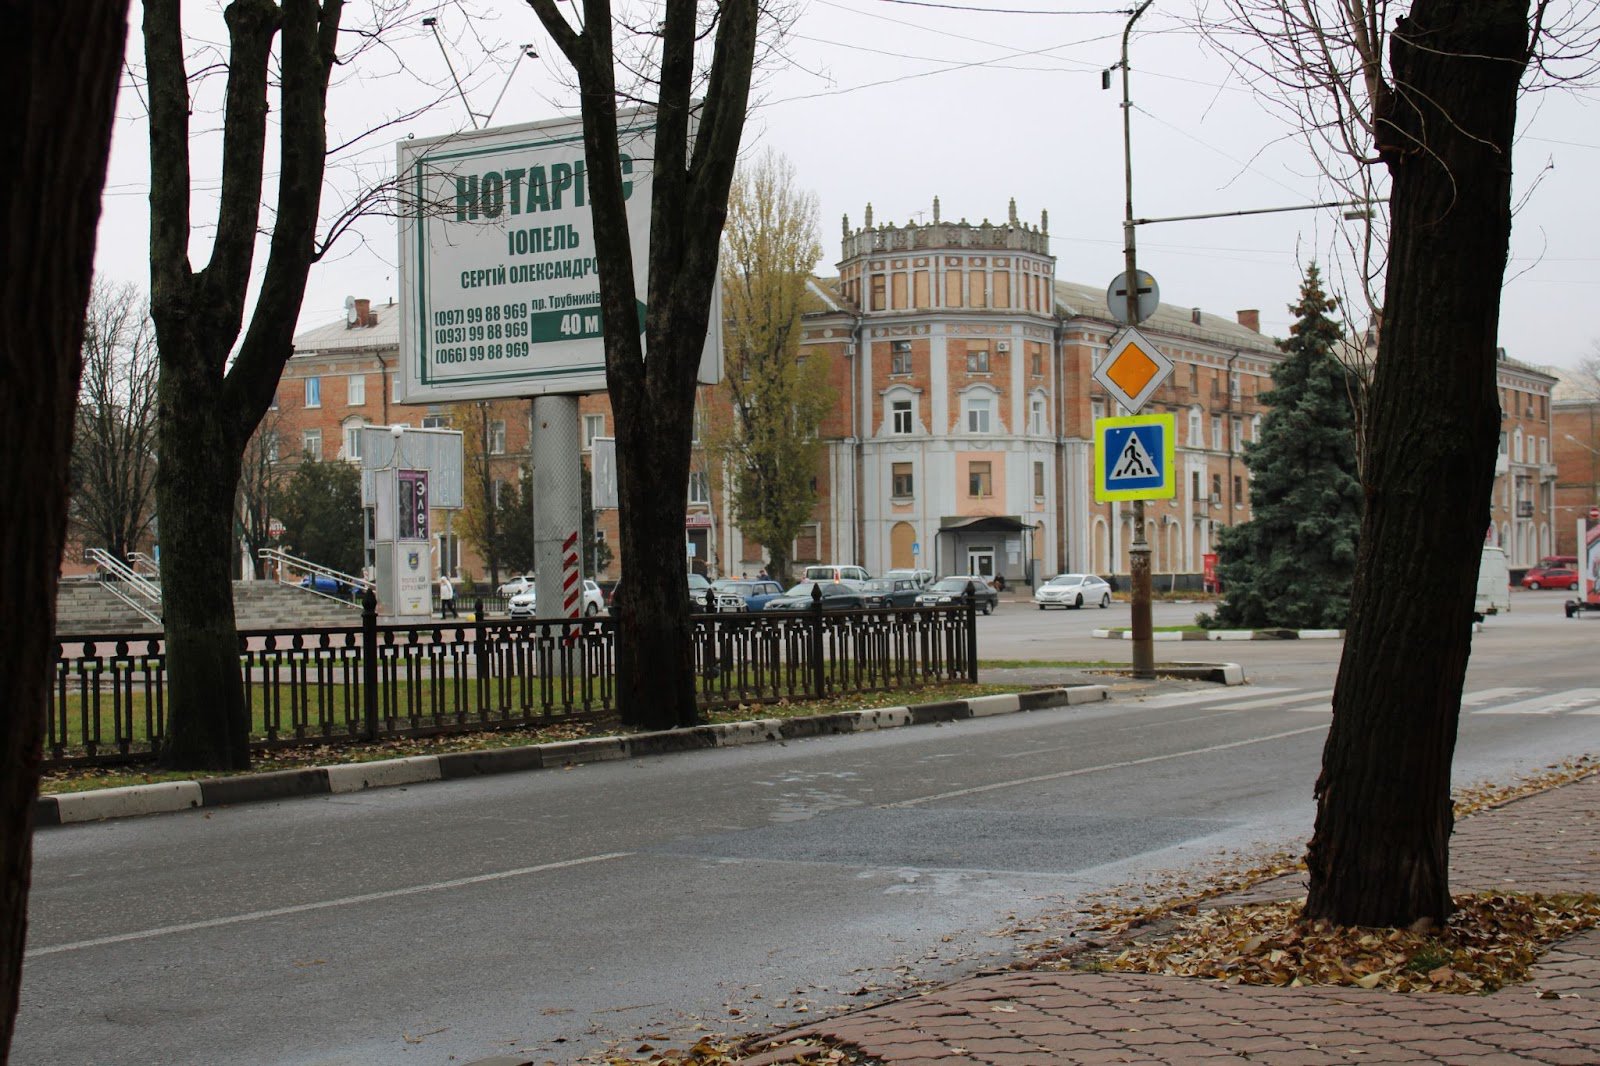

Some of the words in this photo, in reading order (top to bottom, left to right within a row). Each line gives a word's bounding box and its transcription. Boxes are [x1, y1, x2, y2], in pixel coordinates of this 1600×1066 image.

[456, 153, 633, 222] НОТАРІС
[508, 224, 580, 256] ІОПЕЛЬ
[461, 264, 506, 289] СЕРГІЙ
[532, 298, 547, 310] пр.
[548, 291, 601, 309] Трубників
[435, 309, 464, 326] (097)
[467, 307, 482, 323] 99
[485, 305, 501, 322] 88
[503, 303, 527, 320] 969
[560, 313, 581, 335] 40
[435, 327, 466, 344] (093)
[469, 326, 484, 341] 99
[487, 324, 502, 340] 88
[505, 321, 528, 338] 969
[436, 347, 466, 364] (066)
[470, 345, 485, 361] 99
[487, 344, 502, 360] 88
[506, 341, 529, 358] 969
